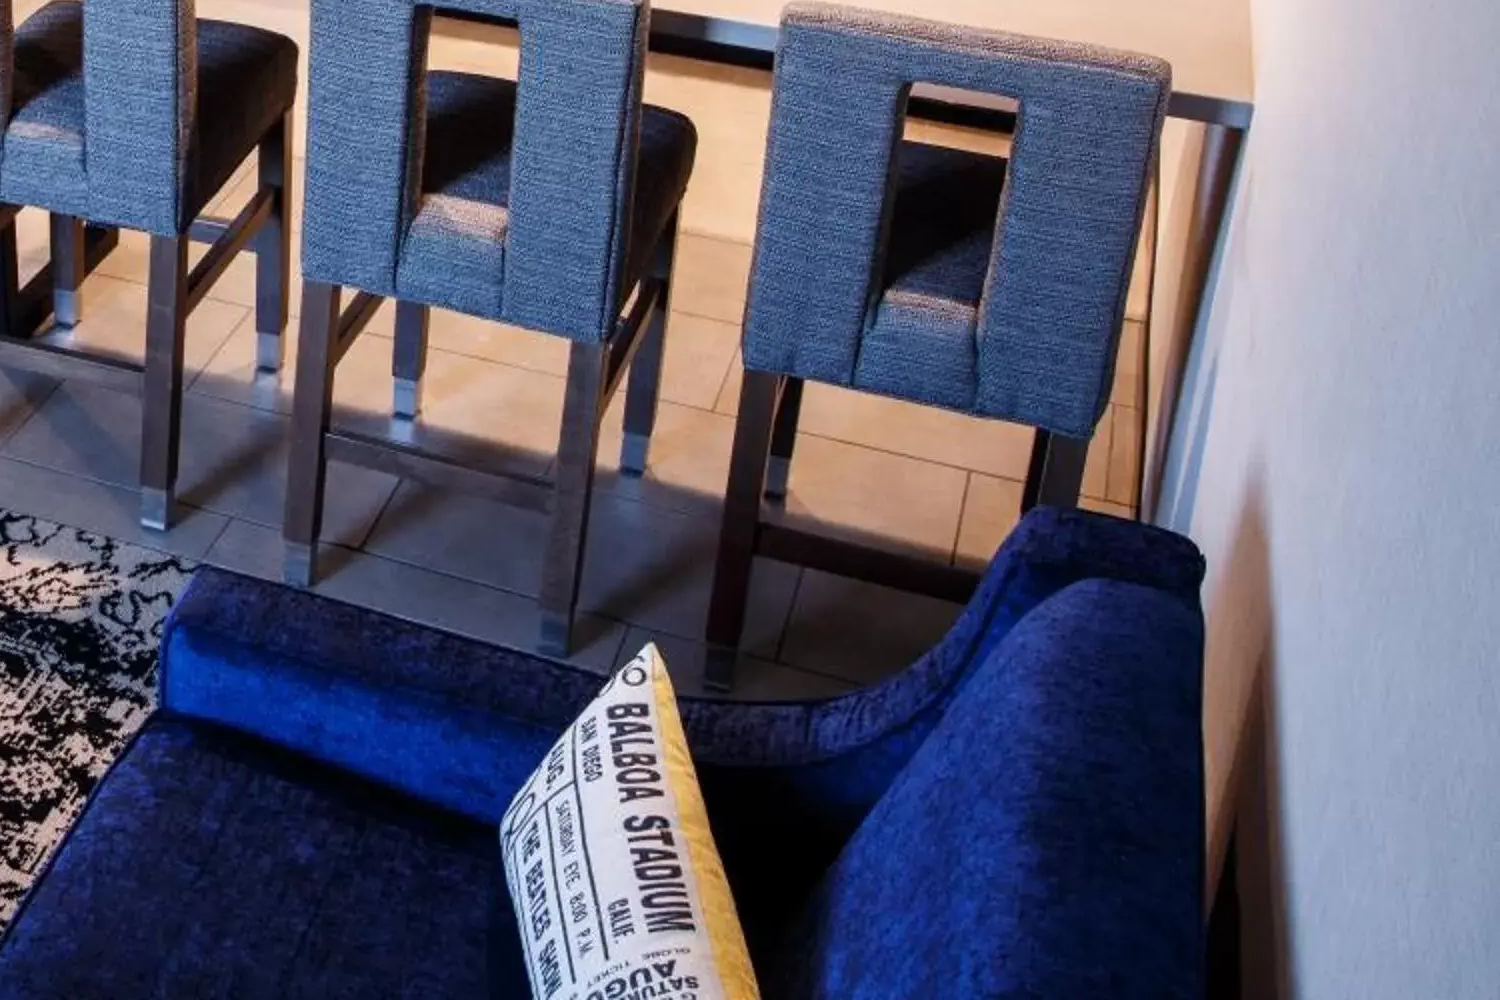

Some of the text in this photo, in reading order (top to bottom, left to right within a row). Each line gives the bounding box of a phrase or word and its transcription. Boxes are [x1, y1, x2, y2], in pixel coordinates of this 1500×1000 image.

[606, 703, 664, 803] BALBOA
[555, 799, 576, 856] SATURDAY
[569, 892, 588, 923] 8:00
[580, 716, 635, 944] SAN DIEGO CALIF.
[623, 815, 695, 933] STADIUM
[521, 820, 562, 1000] THE BEATLES SHOW
